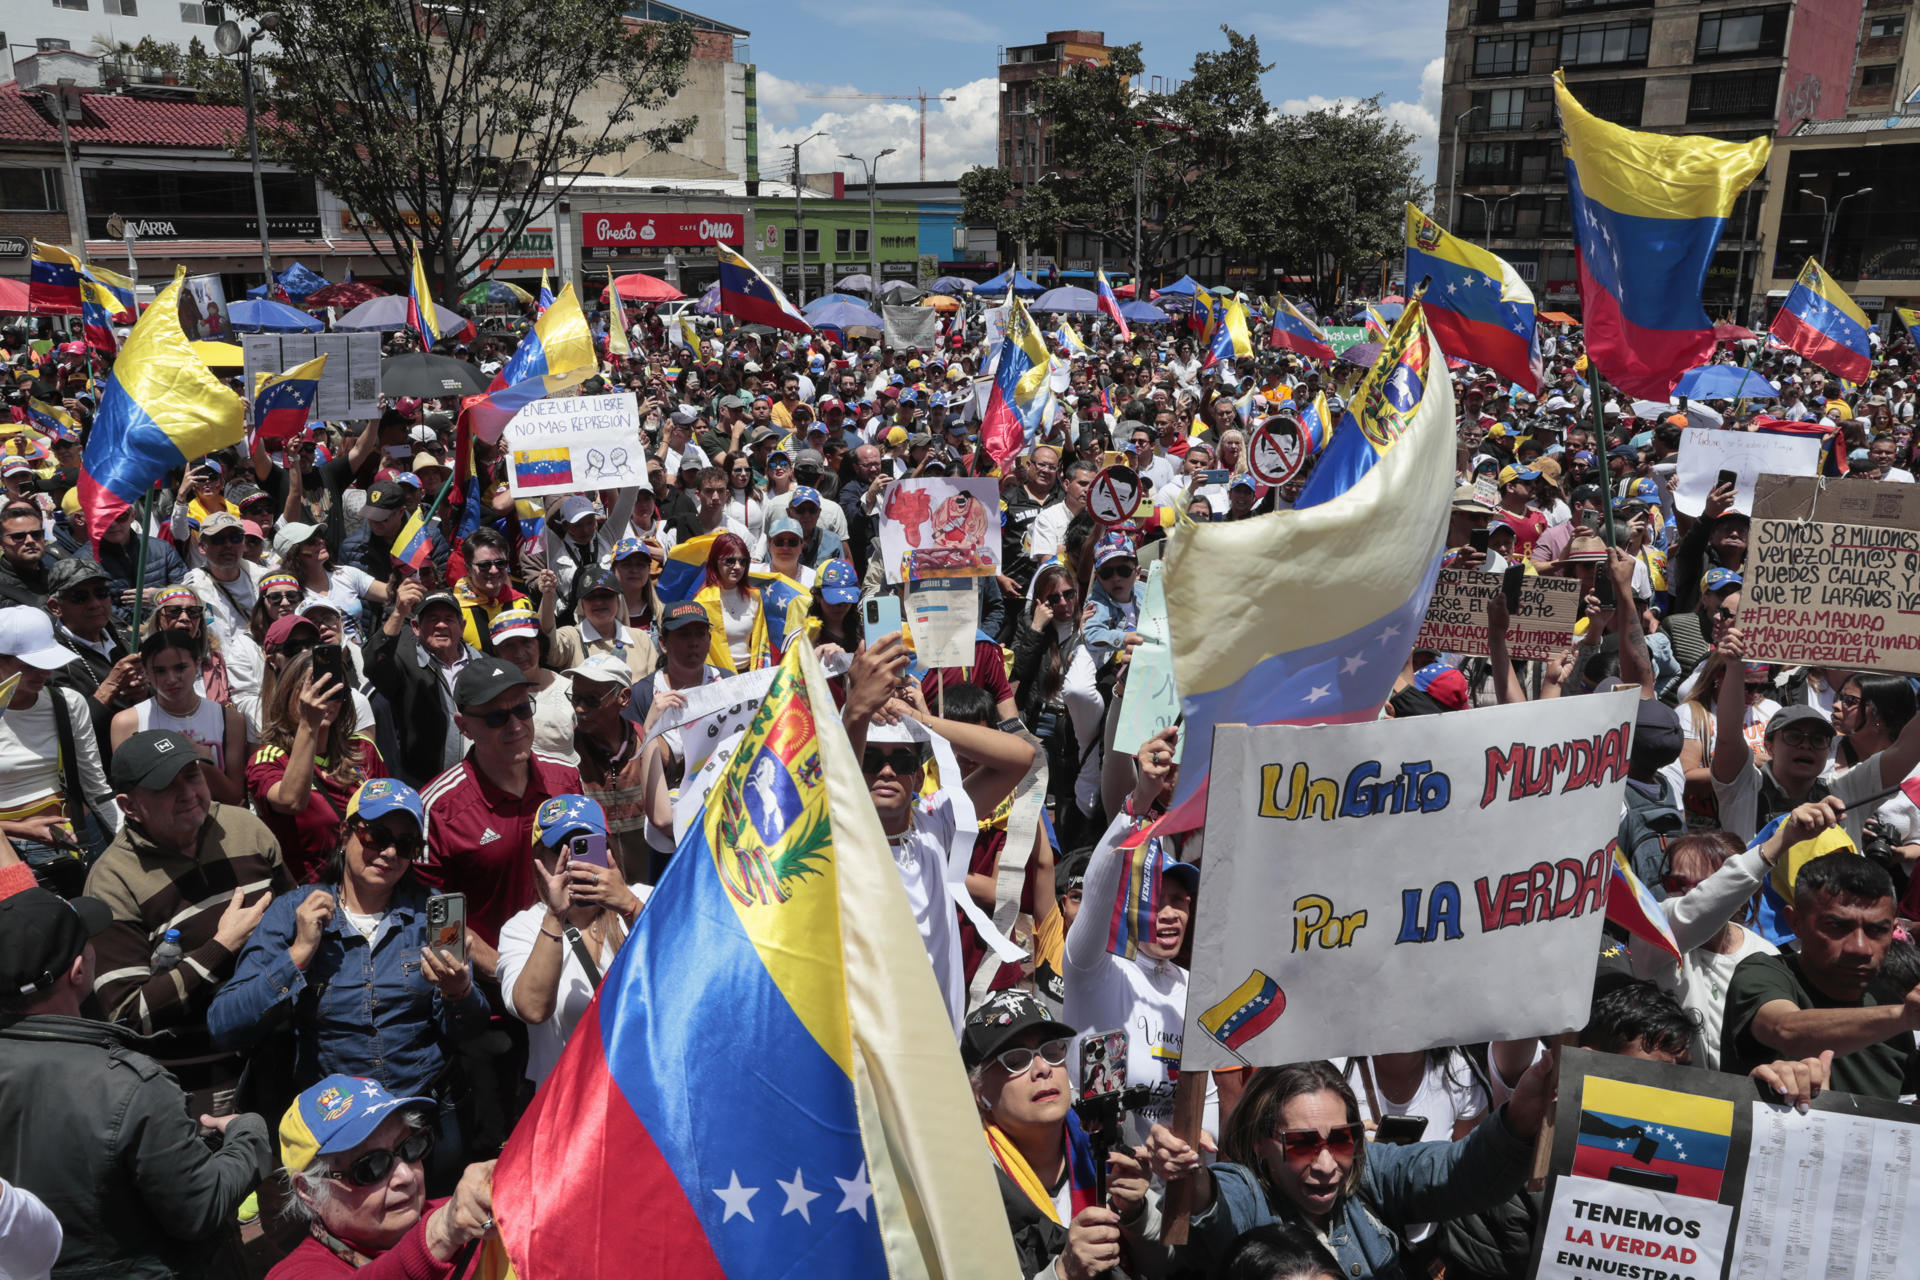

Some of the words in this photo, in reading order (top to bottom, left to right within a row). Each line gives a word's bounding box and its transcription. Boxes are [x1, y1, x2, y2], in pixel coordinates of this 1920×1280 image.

[596, 218, 637, 241] Presto
[699, 219, 734, 240] Oma
[1324, 328, 1351, 342] hasta
[1352, 328, 1364, 341] el
[594, 397, 624, 412] LIBRE
[515, 422, 536, 436] NO
[538, 421, 567, 434] MAS
[1758, 521, 1824, 545] SOMOS
[1831, 525, 1847, 546] 8
[1467, 571, 1499, 585] ERES
[1828, 567, 1896, 590] CALLAR,
[1901, 572, 1916, 592] Y
[1791, 584, 1812, 605] te
[1534, 603, 1555, 617] te
[1512, 645, 1551, 659] #SOS
[1479, 722, 1632, 810] MUNDIAL
[1140, 842, 1159, 903] VENEZUELA
[1291, 893, 1368, 953] Por
[1395, 880, 1465, 945] LA
[1572, 1198, 1702, 1240] TENEMOS
[1565, 1226, 1595, 1247] LA
[1600, 1232, 1697, 1265] VERDAD
[1556, 1251, 1584, 1268] EN
[1586, 1256, 1697, 1280] NUESTRA
